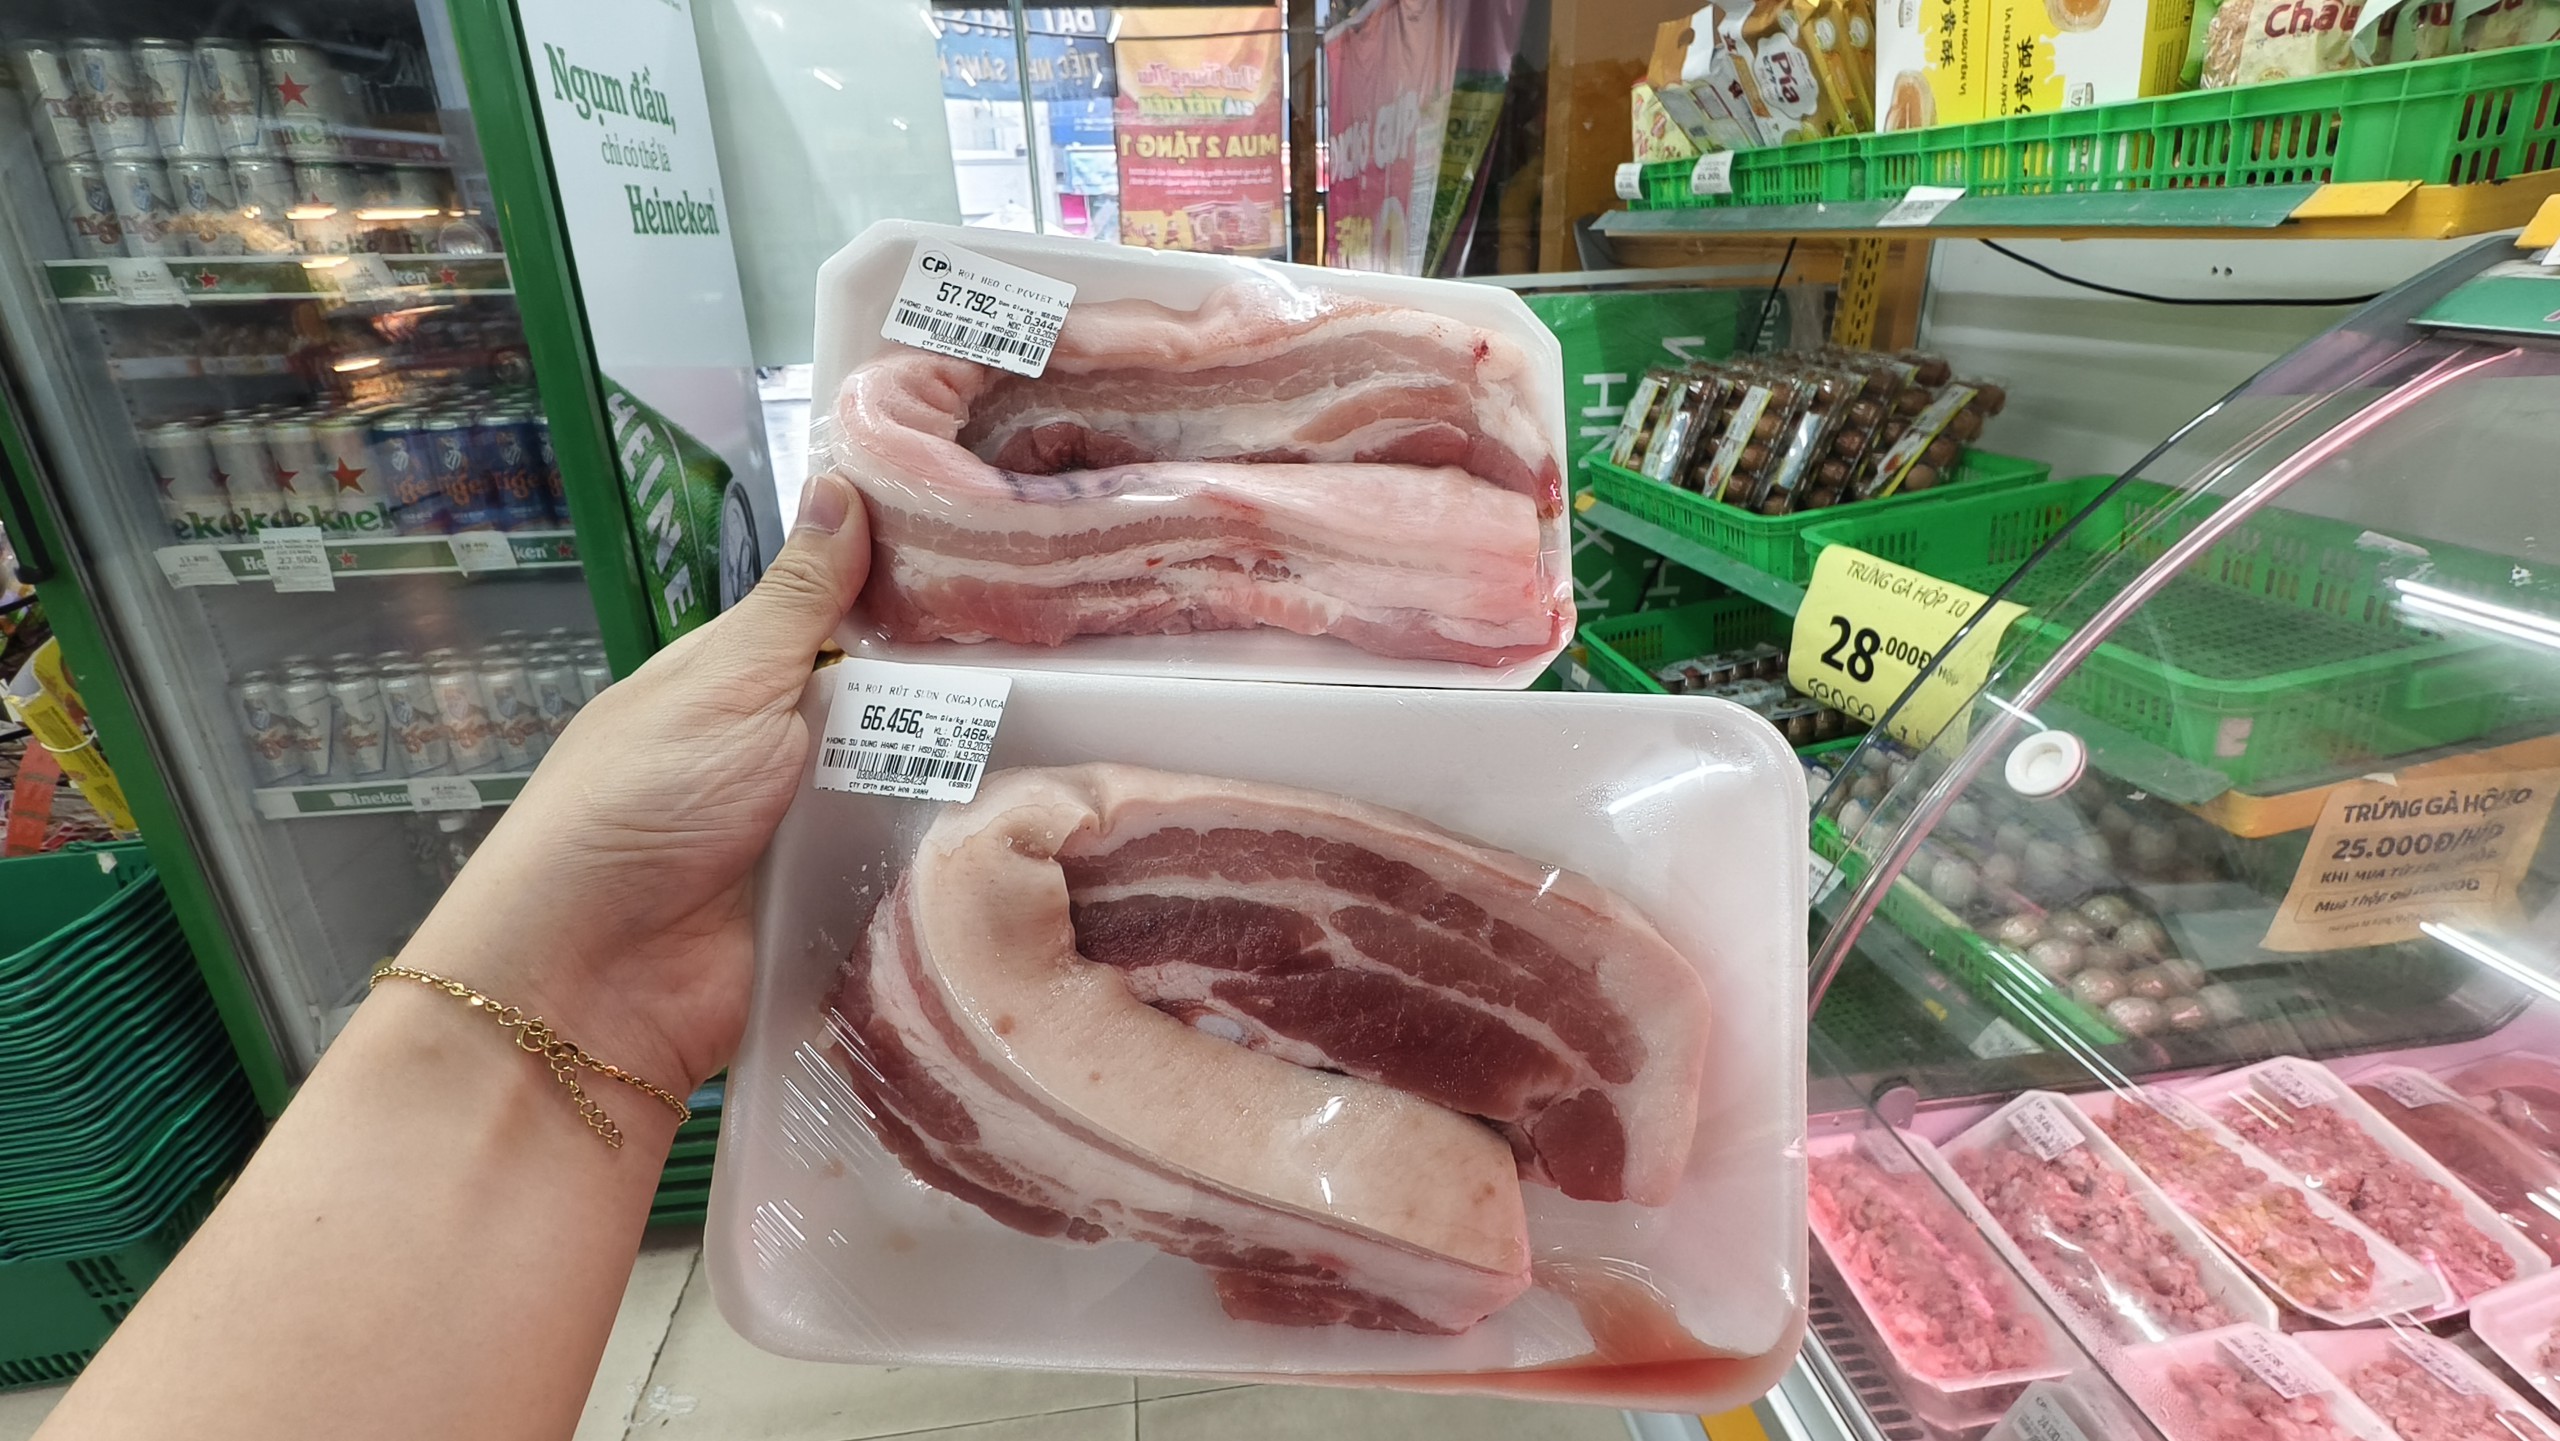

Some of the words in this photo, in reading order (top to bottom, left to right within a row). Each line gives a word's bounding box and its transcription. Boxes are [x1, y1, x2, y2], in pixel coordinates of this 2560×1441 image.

[543, 42, 629, 126] Ngụm
[630, 63, 676, 135] đầu,
[623, 139, 639, 168] có
[624, 184, 720, 235] Heineken
[922, 256, 948, 273] CP
[981, 276, 1000, 289] HEO
[1946, 598, 1970, 618] 10
[901, 743, 915, 752] HET
[2344, 796, 2425, 823] TRỨNG
[2425, 790, 2459, 815] GÀ
[2321, 871, 2349, 884] KHI
[2354, 869, 2385, 881] MUA
